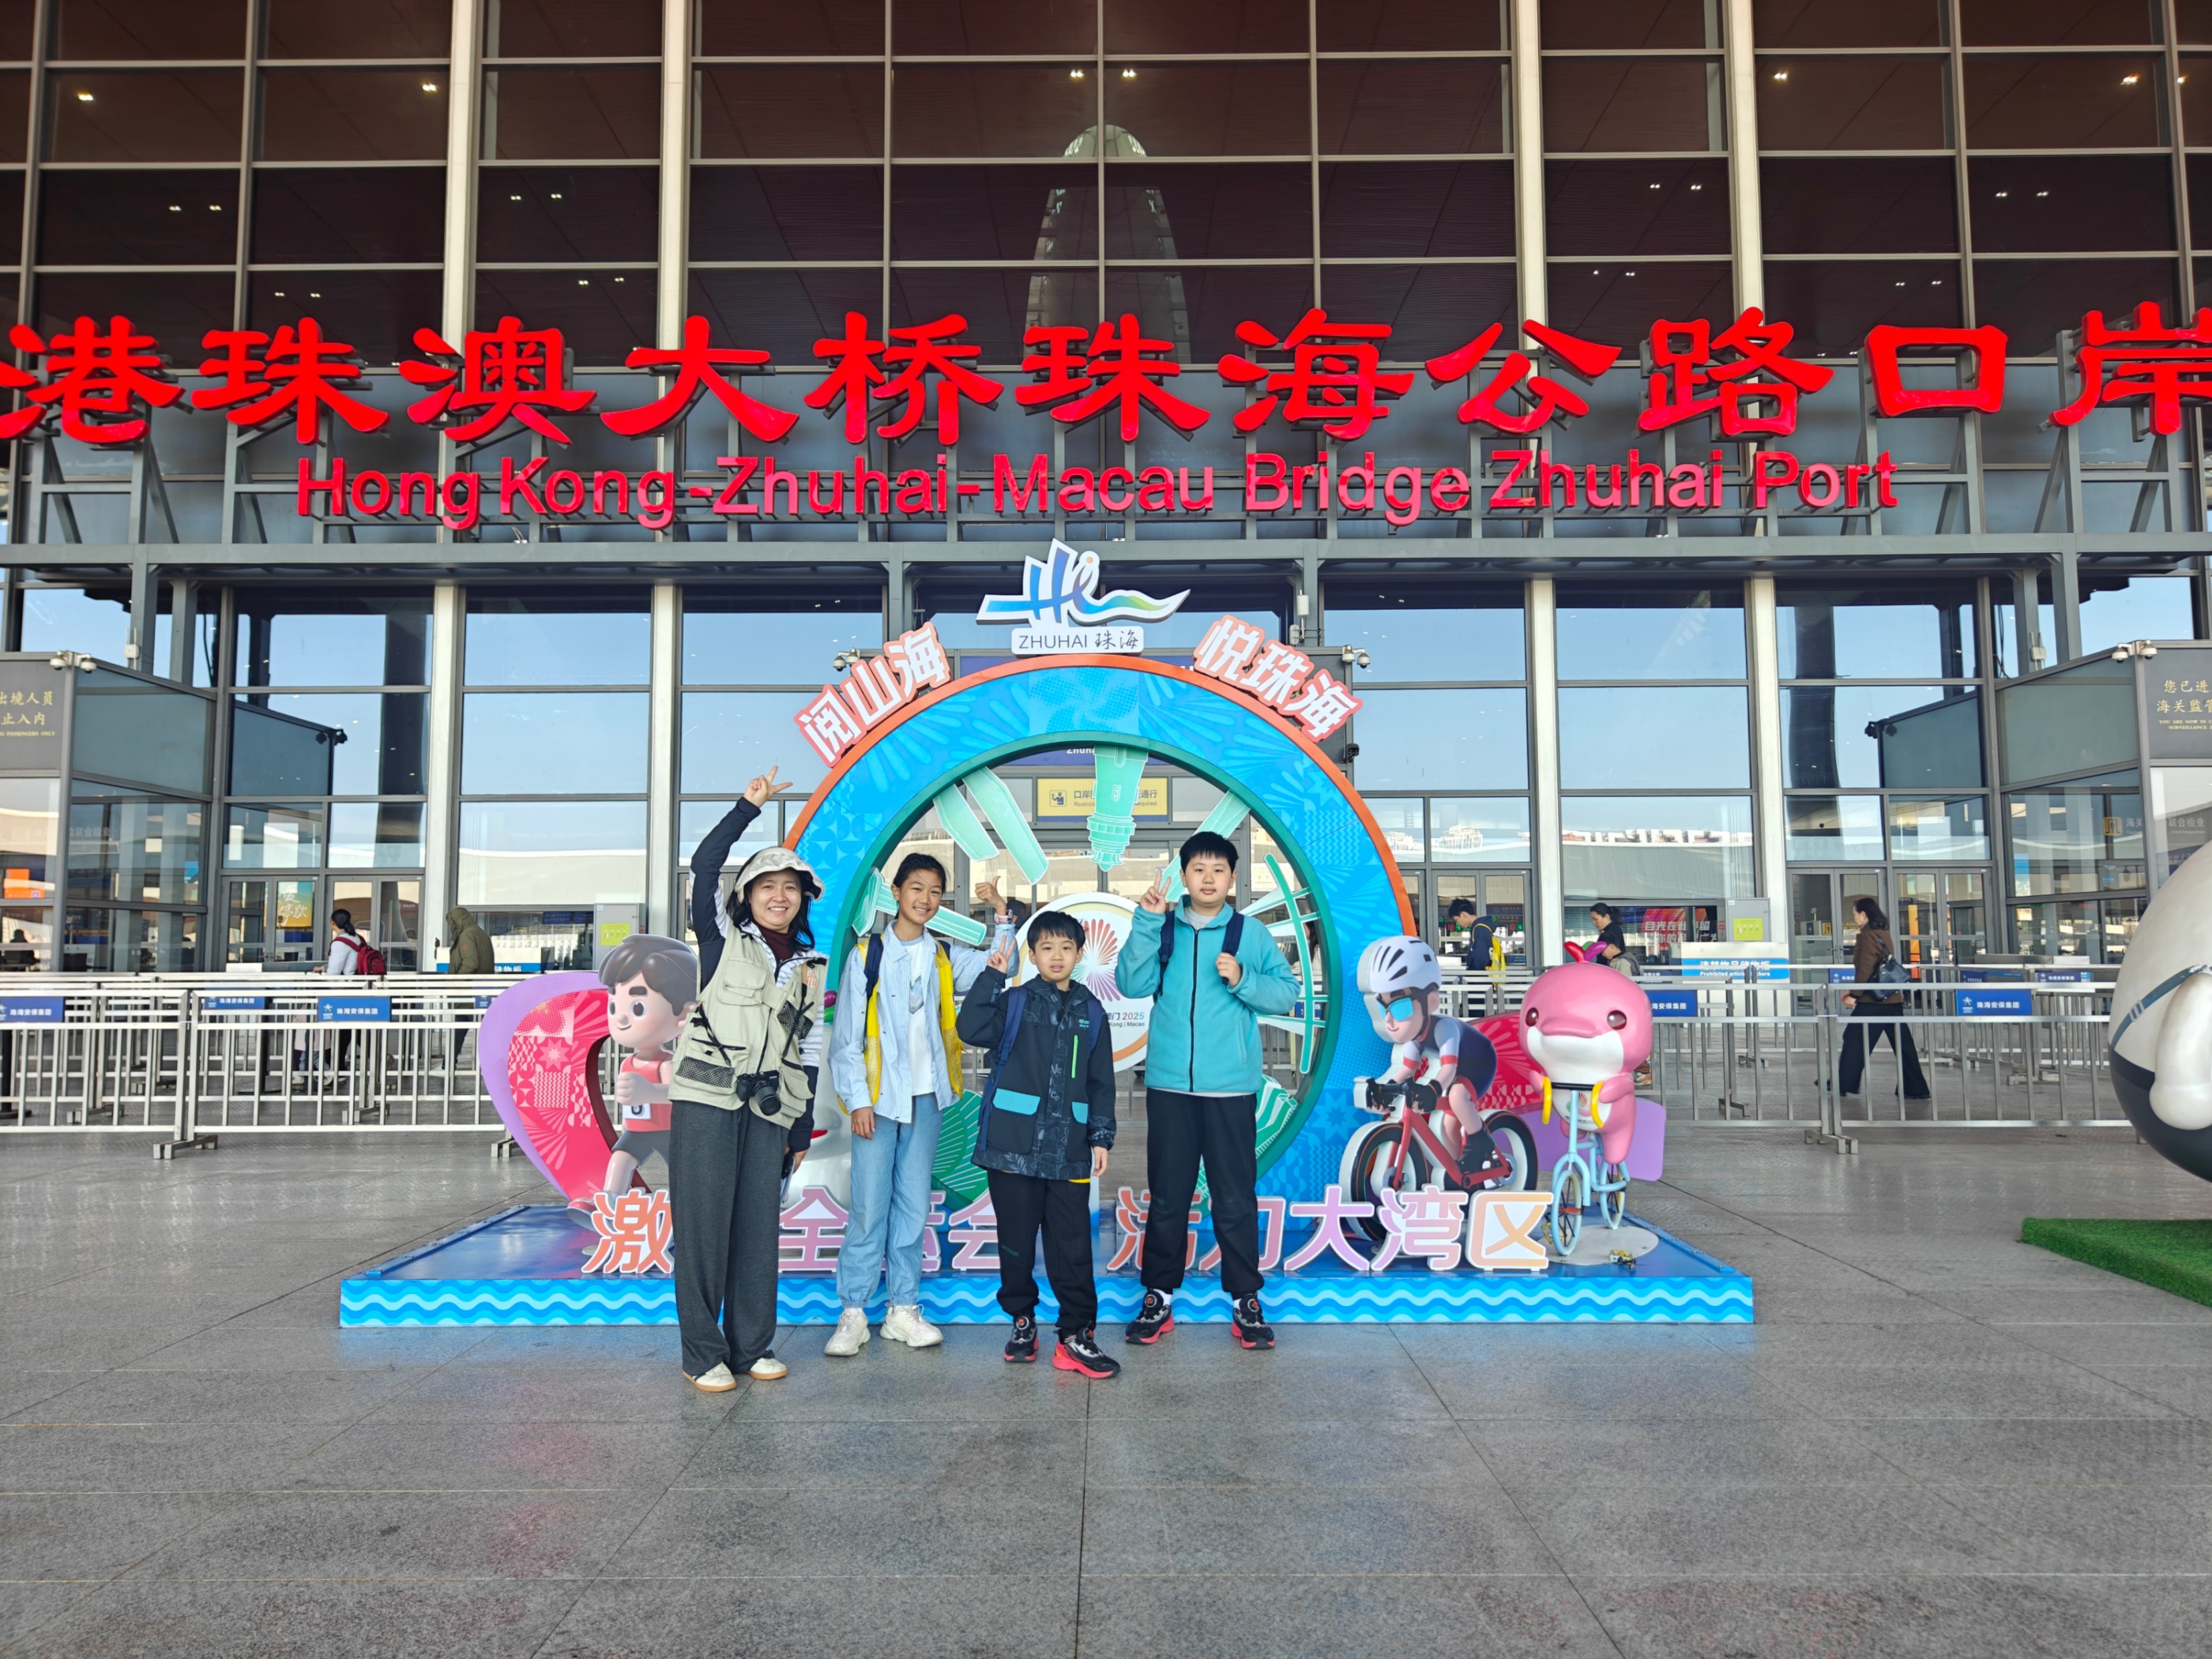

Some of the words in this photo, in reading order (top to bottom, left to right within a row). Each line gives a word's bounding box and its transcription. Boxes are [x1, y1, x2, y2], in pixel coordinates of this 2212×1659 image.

[0, 301, 2212, 445] 港珠澳大桥珠海公路口岸
[297, 457, 479, 530] Hong
[1246, 450, 1469, 526] Bridge
[1490, 449, 1722, 509] Zhuhai
[1754, 450, 1898, 508] Port
[1018, 634, 1088, 649] ZHUHAI
[1094, 630, 1138, 650] 珠海
[797, 626, 946, 764] 阅山海
[1198, 619, 1359, 739] 悦珠海
[2166, 817, 2206, 828] 联合检查
[1645, 920, 1710, 931] 目光在此留
[1122, 1012, 1145, 1021] 2025
